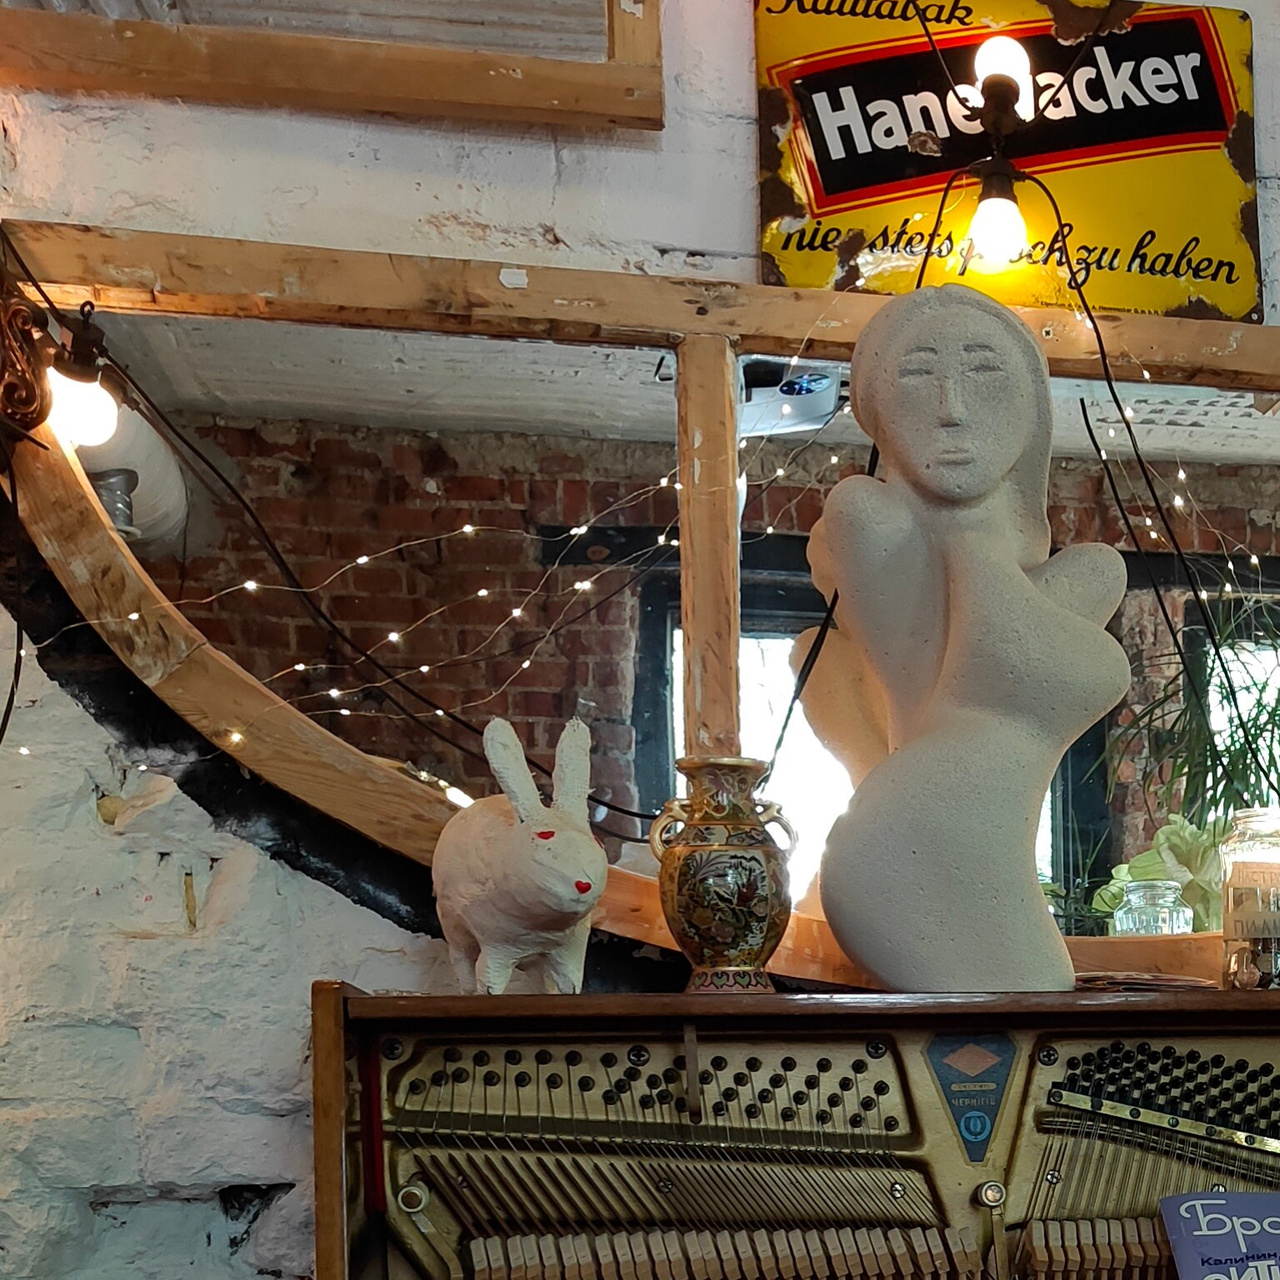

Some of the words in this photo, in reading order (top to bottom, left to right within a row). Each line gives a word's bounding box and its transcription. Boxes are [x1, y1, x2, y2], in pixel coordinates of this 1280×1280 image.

[812, 46, 1200, 160] Haneacker
[1067, 245, 1120, 290] zu
[1126, 230, 1240, 285] haben
